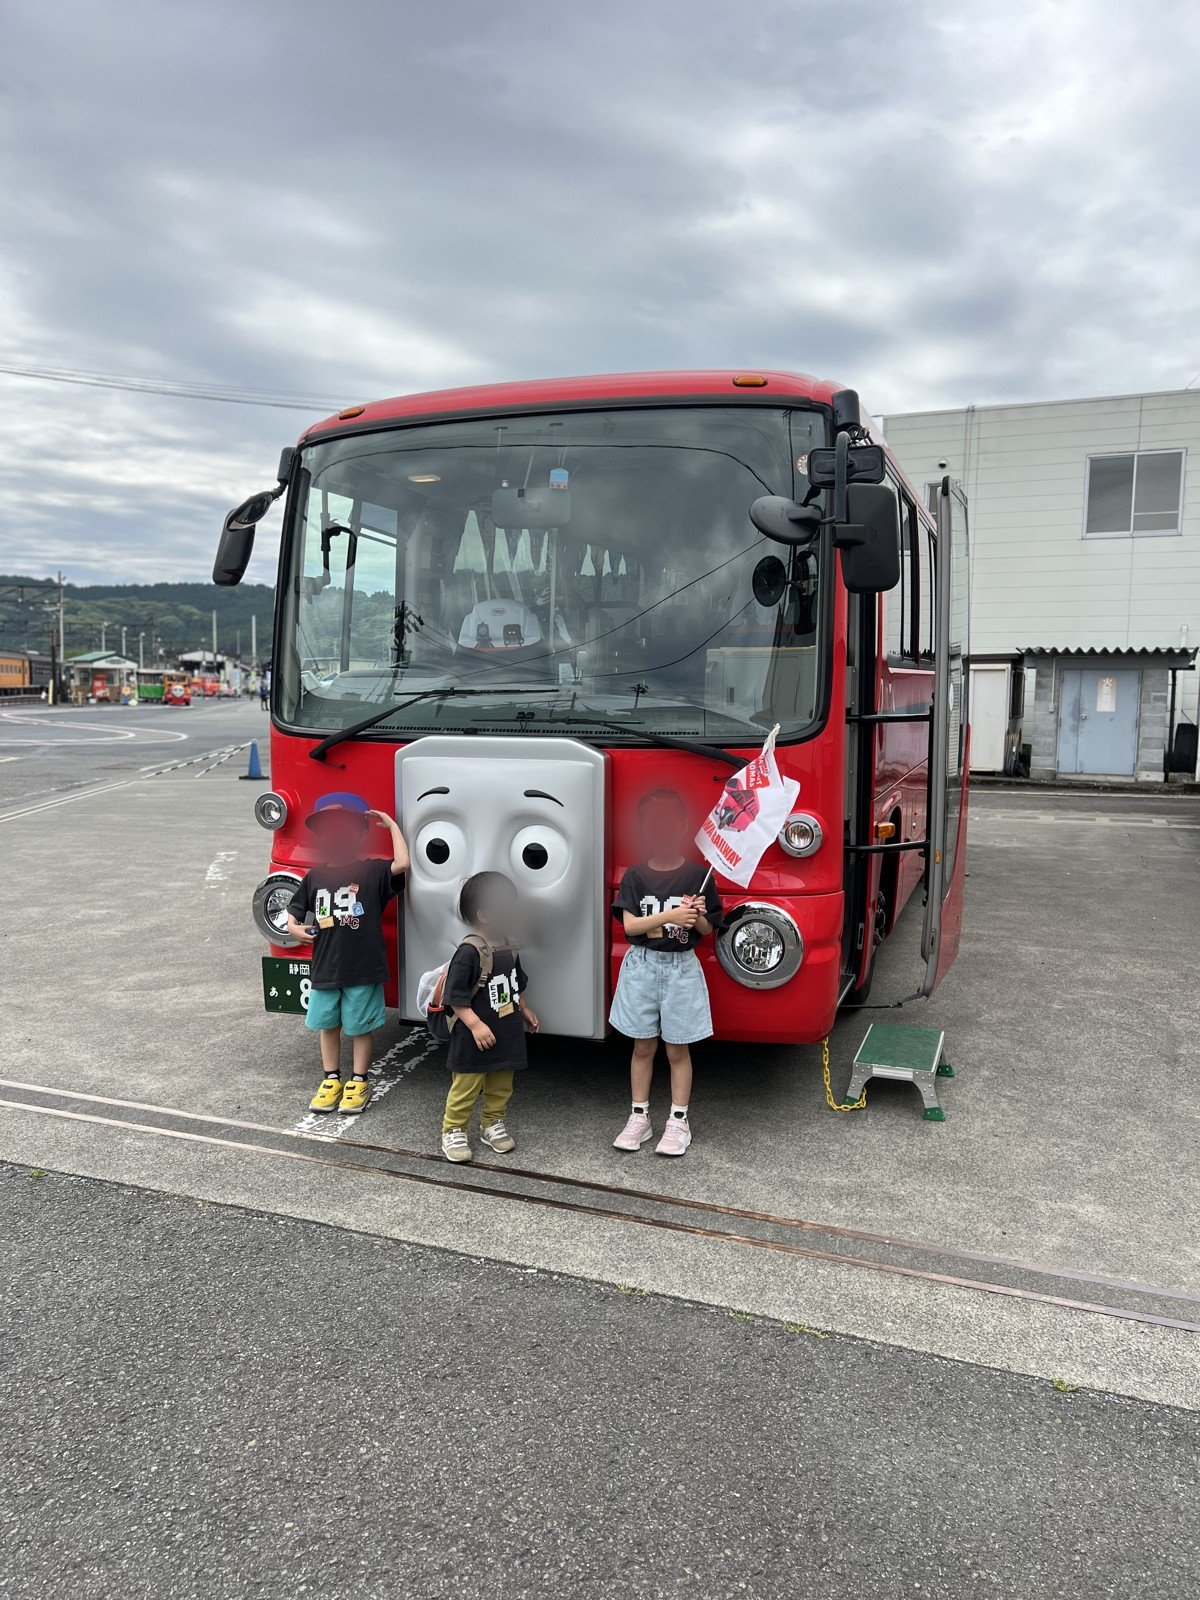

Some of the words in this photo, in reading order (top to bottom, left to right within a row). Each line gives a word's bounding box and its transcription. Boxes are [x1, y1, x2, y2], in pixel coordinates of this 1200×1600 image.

[340, 915, 360, 930] MC
[668, 926, 689, 944] MC
[288, 963, 310, 976] 静岡
